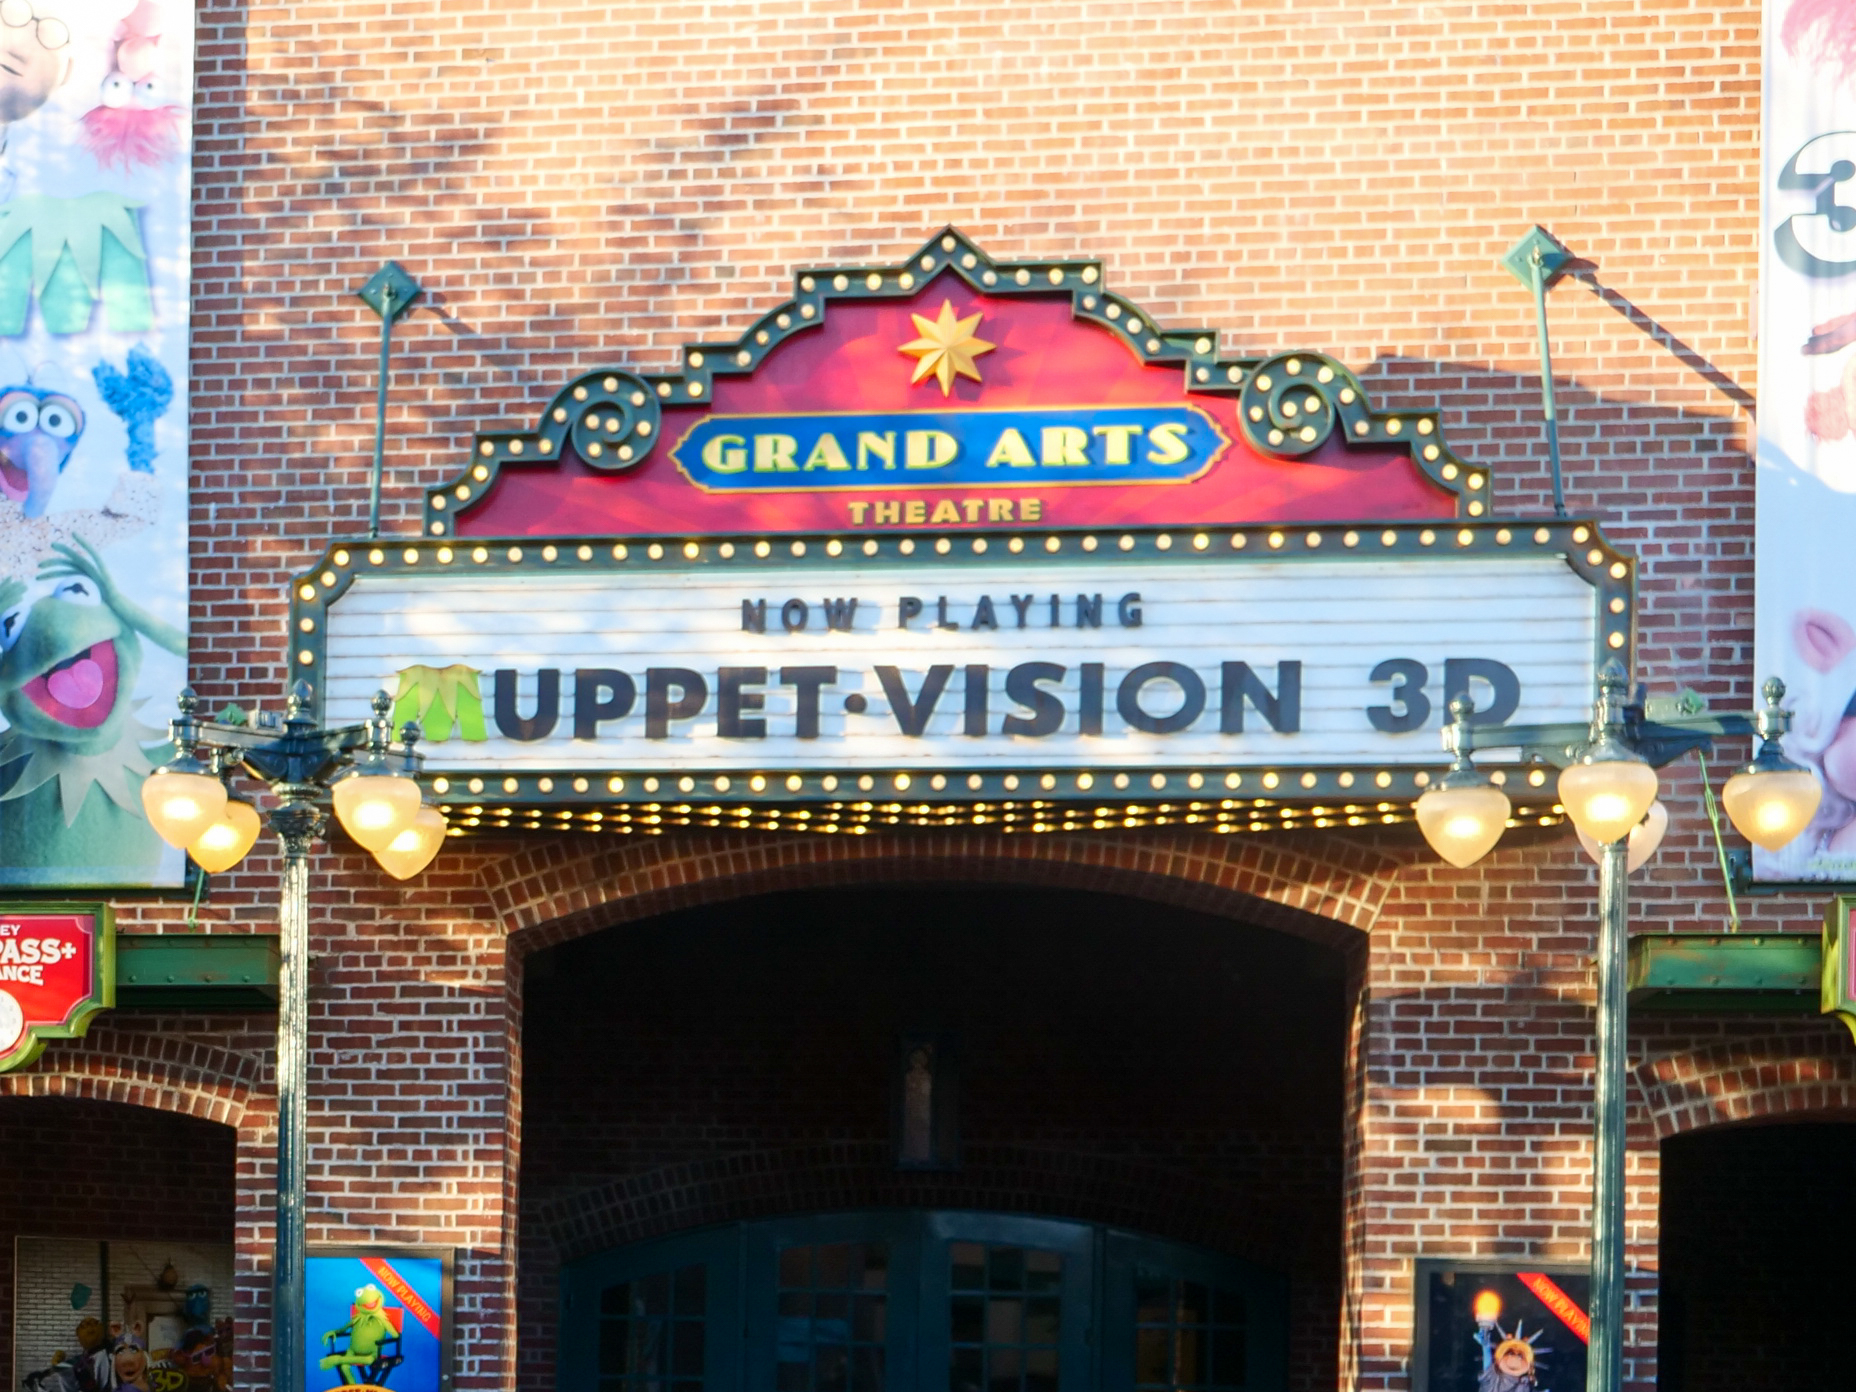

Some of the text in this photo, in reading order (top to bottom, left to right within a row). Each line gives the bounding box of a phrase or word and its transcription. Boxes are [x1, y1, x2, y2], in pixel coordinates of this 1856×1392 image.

[701, 422, 1191, 474] GRAND ARTS
[847, 498, 1042, 526] THEATRE
[741, 592, 1143, 633] NOW PLAYING
[1366, 657, 1522, 734] 3D
[378, 1266, 432, 1322] NOW PLAYING
[1533, 1278, 1559, 1303] NOW
